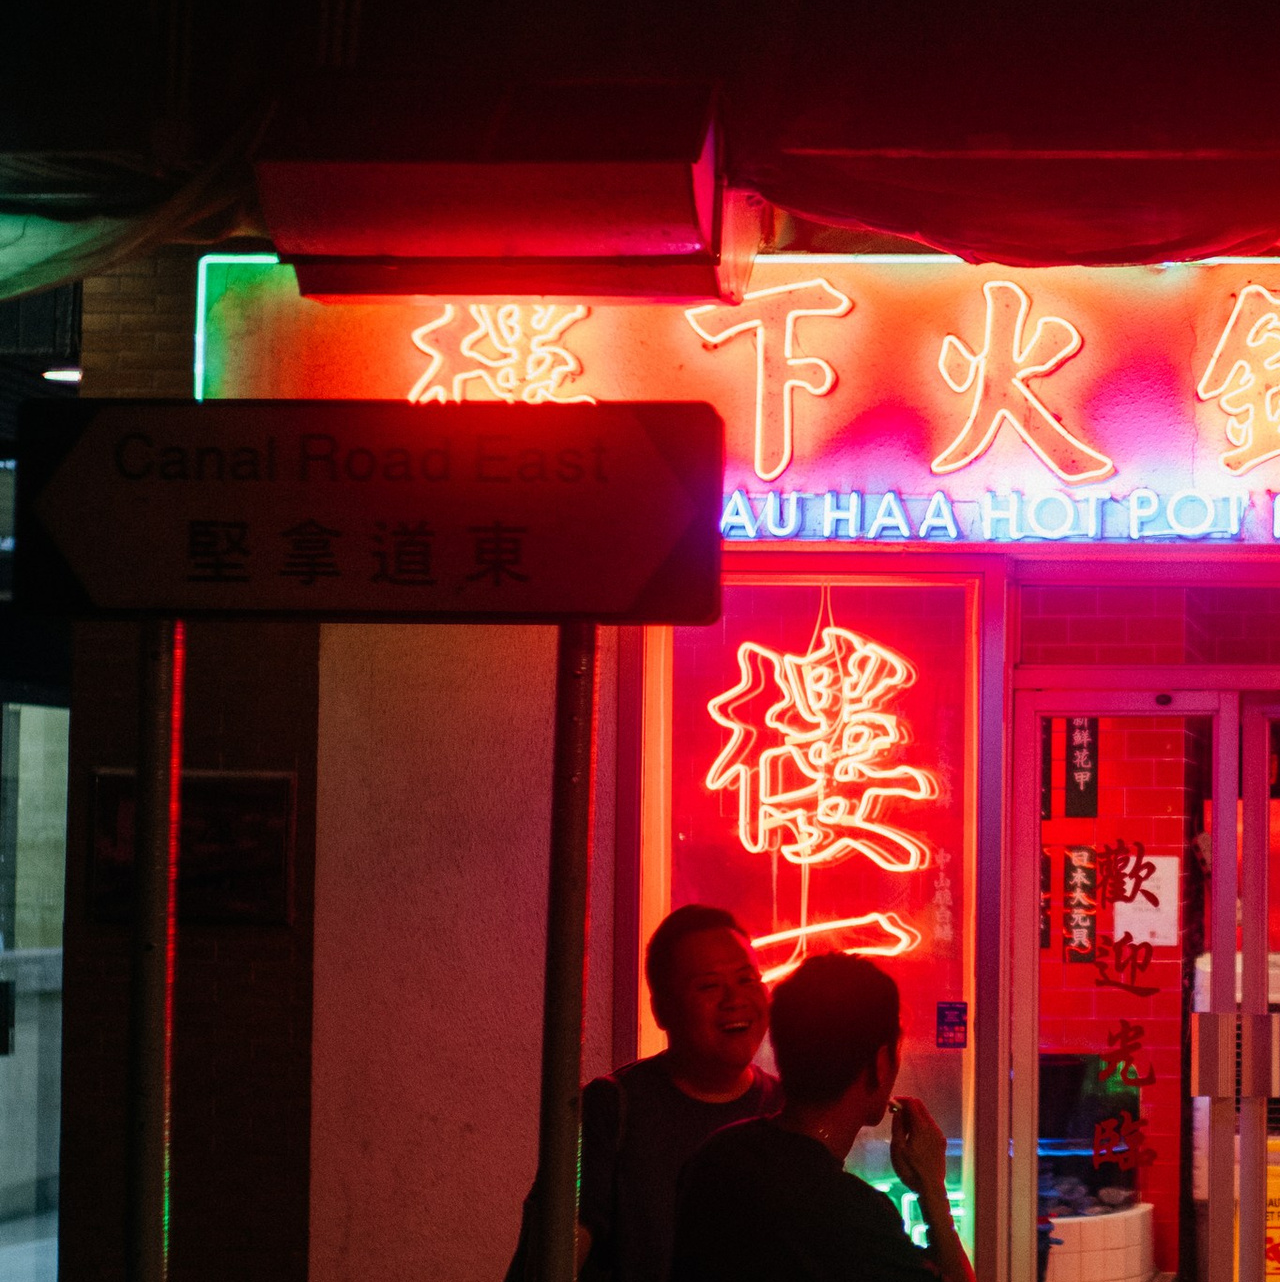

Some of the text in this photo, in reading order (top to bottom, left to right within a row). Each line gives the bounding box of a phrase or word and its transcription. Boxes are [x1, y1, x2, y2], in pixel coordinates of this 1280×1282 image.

[113, 431, 610, 484] Canal Road East
[720, 488, 801, 538] AU
[822, 489, 959, 539] HAA
[982, 489, 1112, 539] HOT
[1128, 488, 1248, 539] POT
[186, 518, 530, 587] 堅拿道東
[1093, 837, 1161, 1173] 歡迎光臨
[1266, 1211, 1275, 1221] ET
